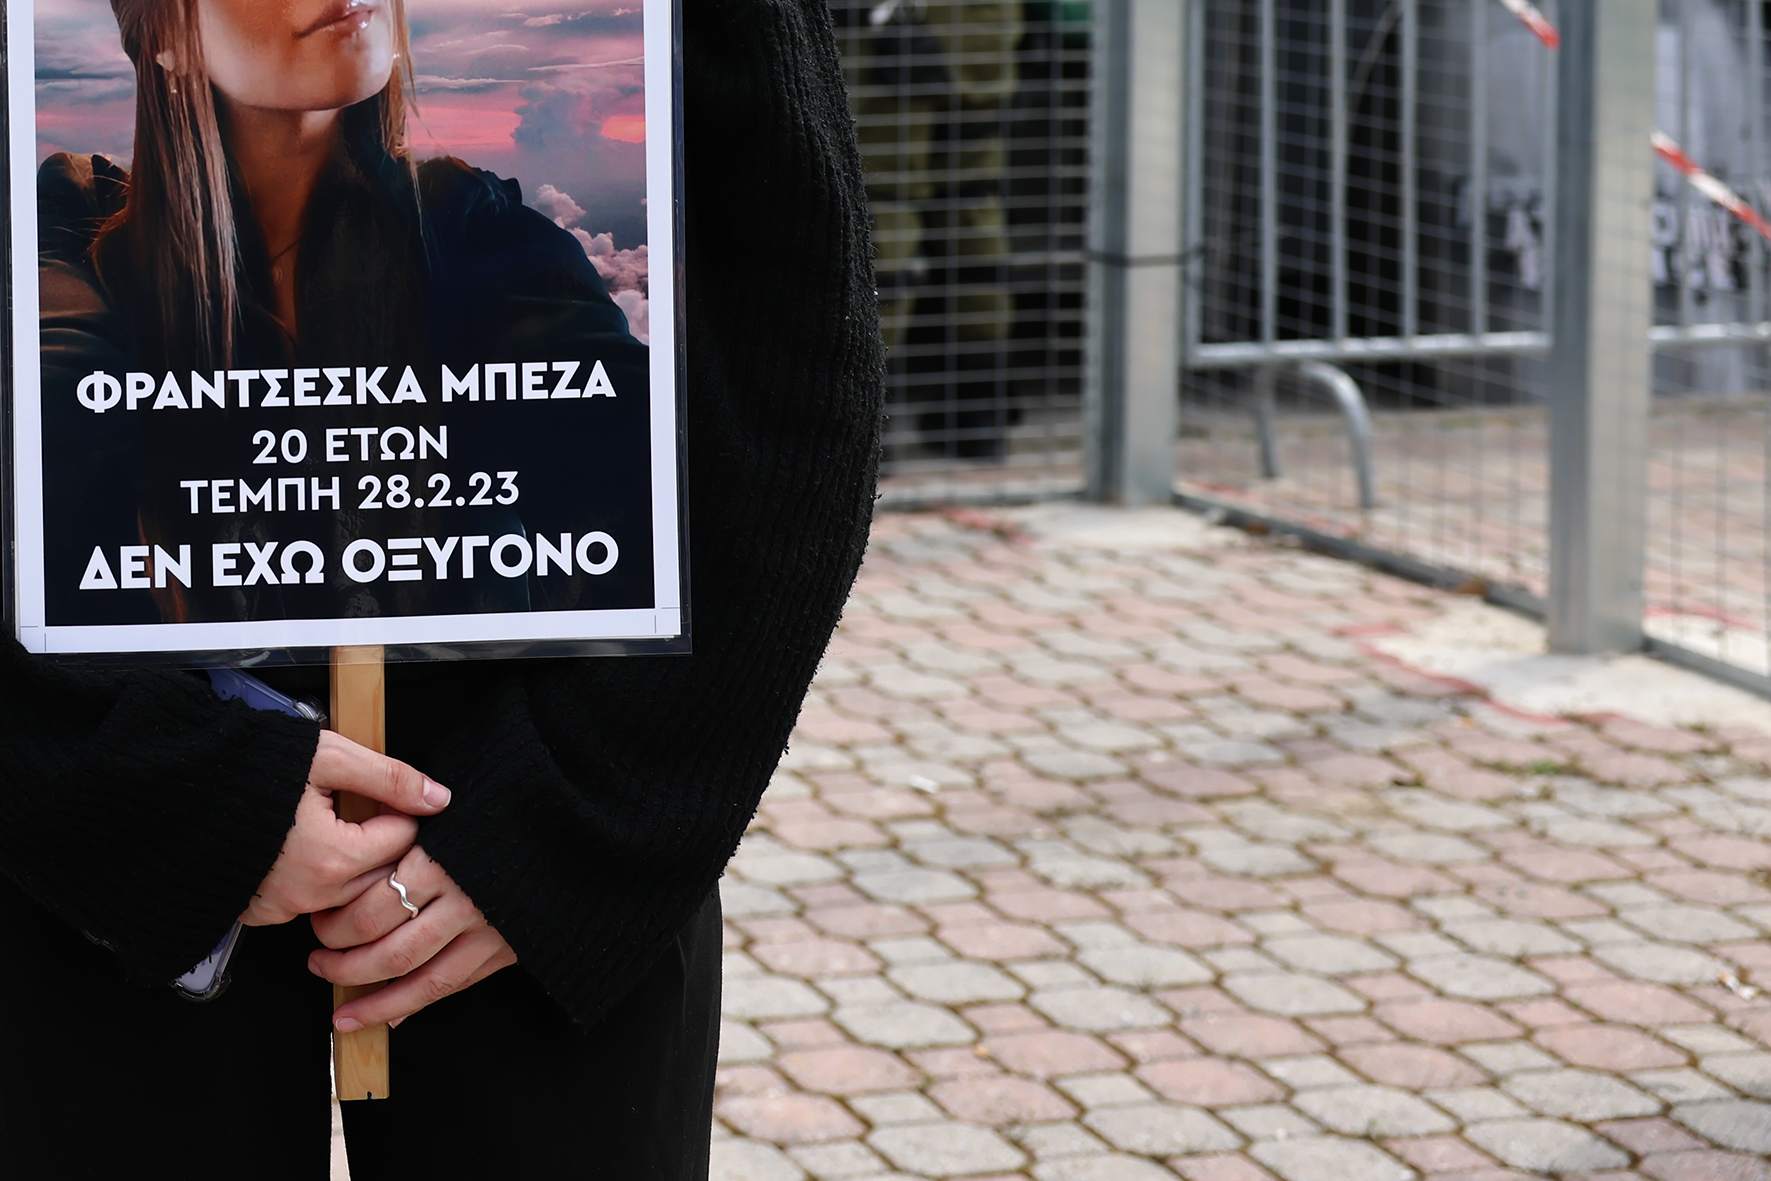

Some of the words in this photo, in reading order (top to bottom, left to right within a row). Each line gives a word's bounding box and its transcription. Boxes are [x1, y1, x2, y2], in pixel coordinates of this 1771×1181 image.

[77, 366, 426, 413] ΦΡΑΝΤΣΕΣΚΑ
[442, 360, 616, 402] ΜΠΕΖΑ
[252, 429, 308, 464] 20
[326, 426, 448, 461] ΕΤΩΝ
[180, 477, 340, 514] ΤΕΜΠΗ
[358, 471, 519, 509] 28.2.23
[79, 545, 191, 590] ΔΕΝ
[213, 540, 324, 586] ΕΧΩ
[342, 531, 618, 582] ΟΞΥΓΟΝΟ
